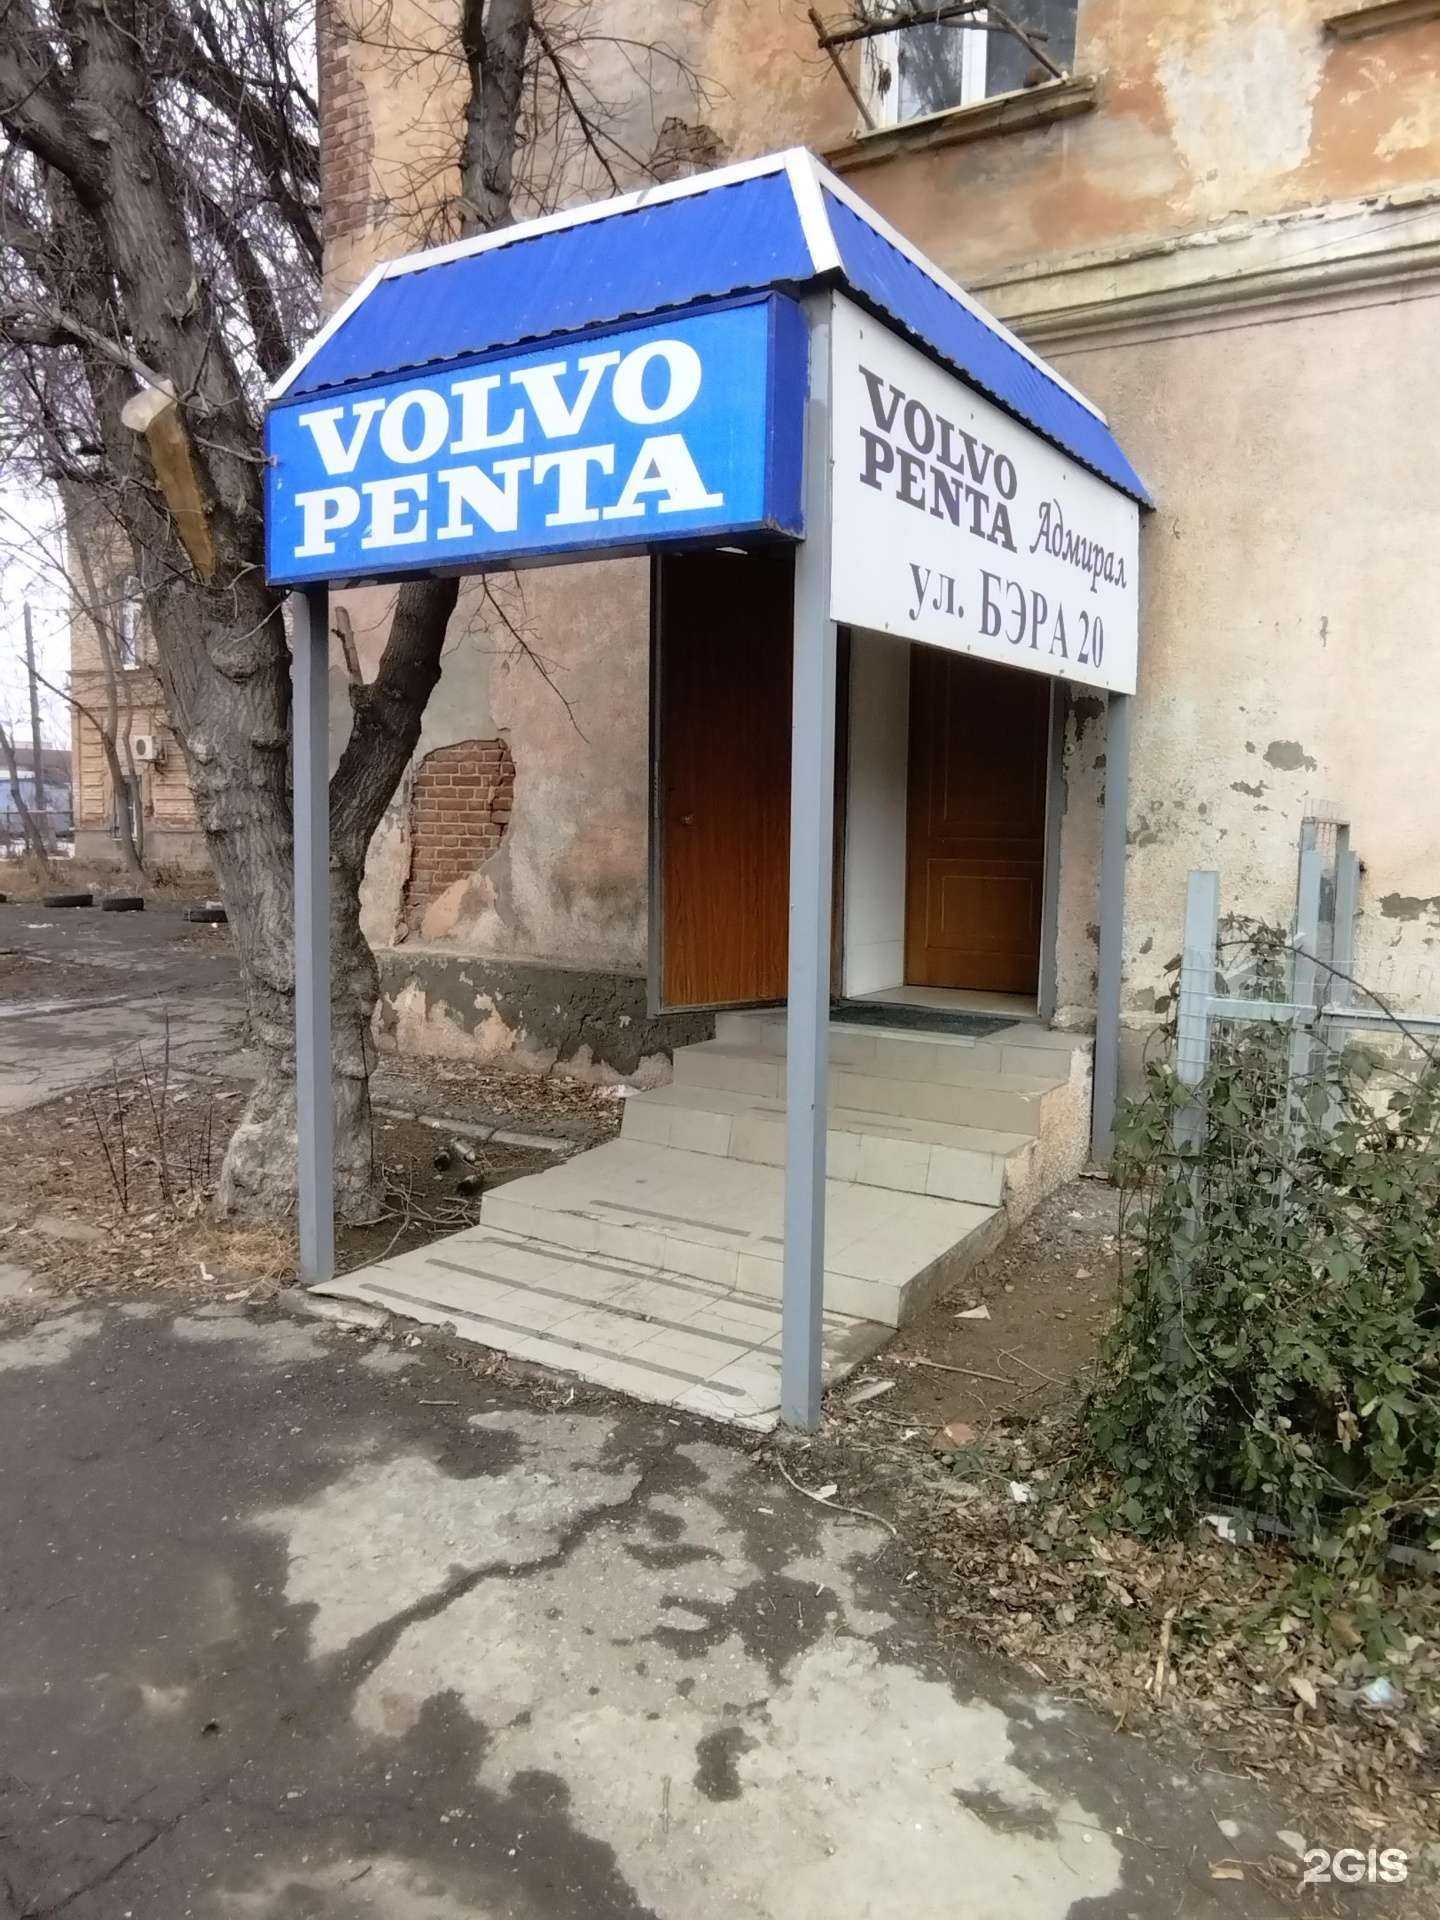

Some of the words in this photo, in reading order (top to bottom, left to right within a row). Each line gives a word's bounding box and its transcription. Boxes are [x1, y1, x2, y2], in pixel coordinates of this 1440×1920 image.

[300, 339, 702, 476] VOLVO
[859, 364, 1017, 501] VOLVO
[294, 433, 723, 558] PENTA
[859, 426, 1018, 554] PENTA
[1029, 498, 1127, 594] Адмирал
[909, 563, 964, 621] ул.
[978, 569, 1069, 659] БЭРА
[1077, 610, 1104, 669] 20
